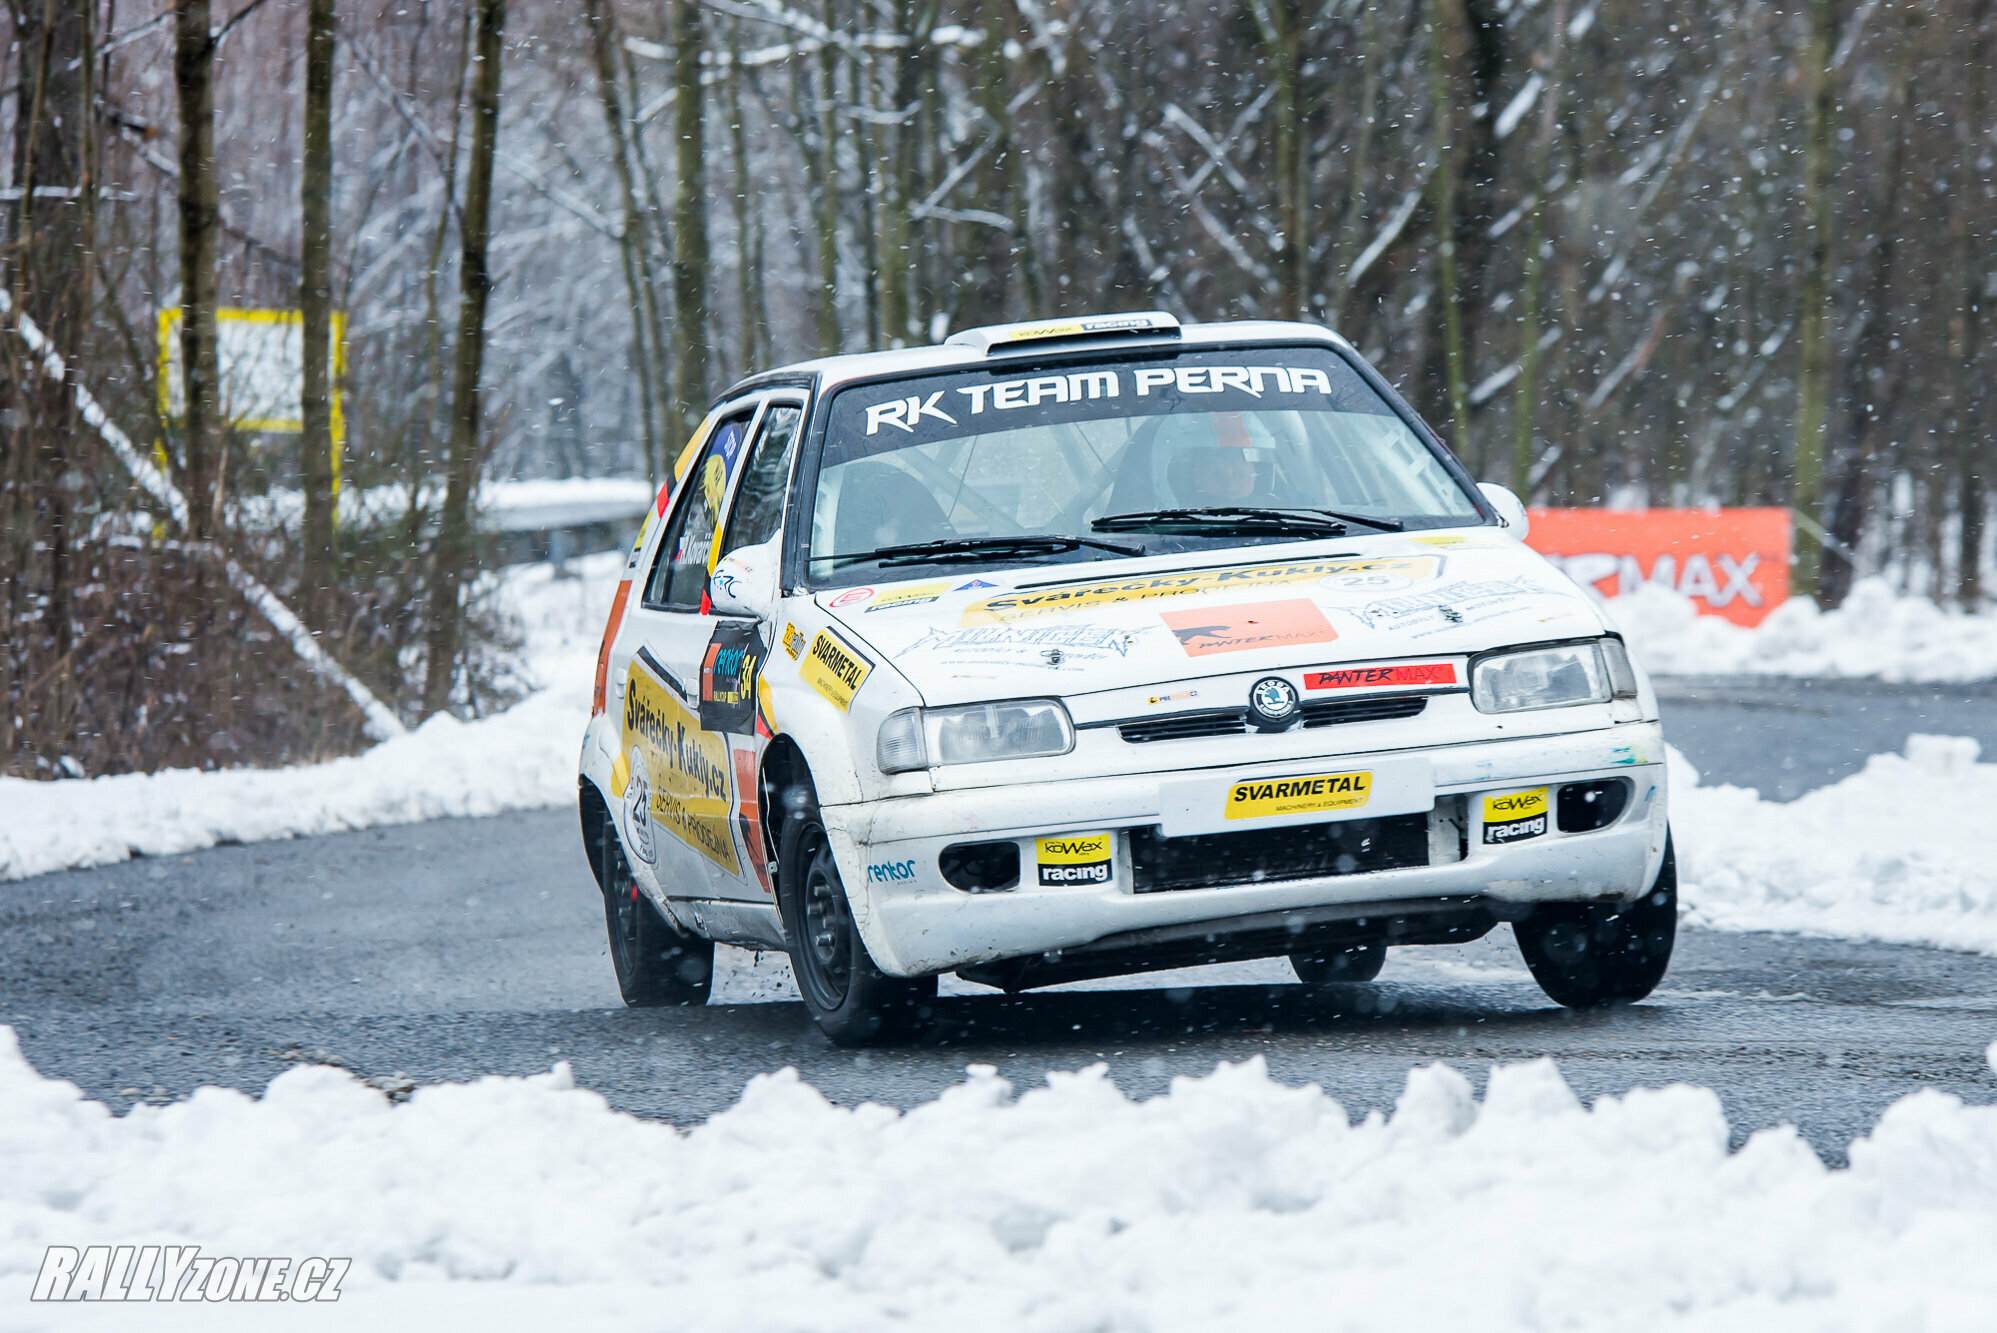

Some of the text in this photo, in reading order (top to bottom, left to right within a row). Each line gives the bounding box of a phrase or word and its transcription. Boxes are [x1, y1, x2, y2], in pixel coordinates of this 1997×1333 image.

[865, 366, 1333, 435] RK TEAM PERNA
[1343, 575, 1391, 587] 25
[1541, 552, 1764, 608] RMAX
[713, 645, 744, 677] rentor
[741, 654, 757, 700] 34
[812, 634, 862, 691] SVARMETAL
[626, 678, 727, 803] Svářečky-Kukly.cz
[632, 775, 648, 827] 25
[656, 785, 681, 825] SERVIS
[1233, 775, 1366, 802] SVARMETAL
[1486, 817, 1545, 839] racing
[867, 859, 916, 883] rentor
[1042, 864, 1108, 882] racing
